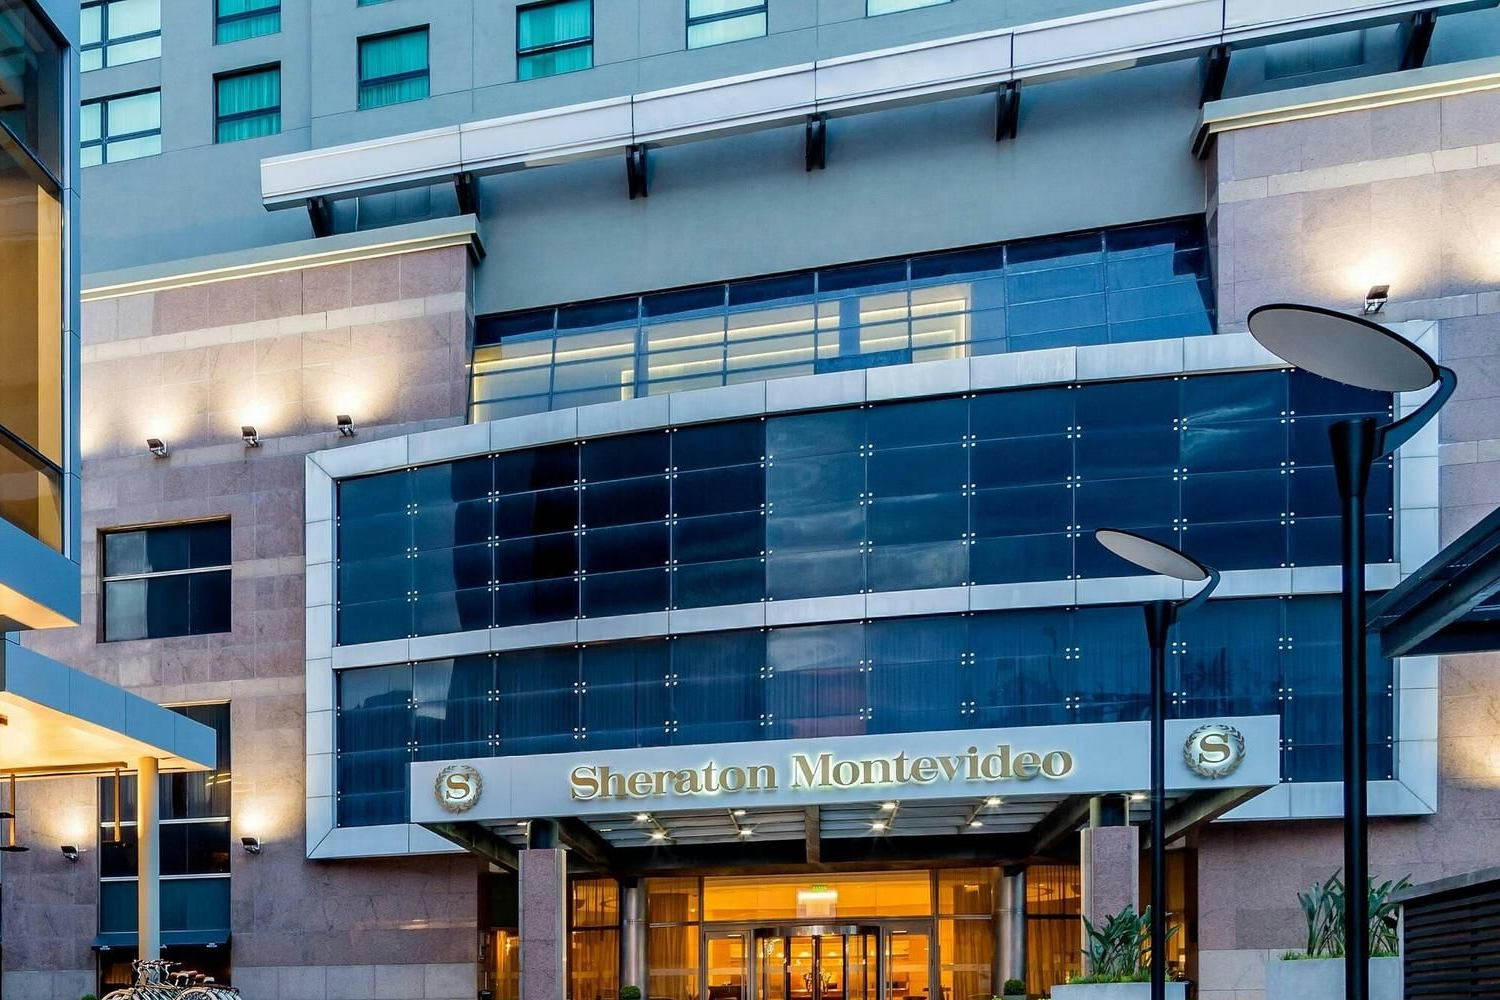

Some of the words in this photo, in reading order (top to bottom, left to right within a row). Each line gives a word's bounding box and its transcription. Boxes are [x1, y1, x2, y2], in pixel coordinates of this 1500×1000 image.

[1199, 733, 1230, 763] S
[446, 773, 469, 799] S
[570, 761, 777, 799] Sheraton
[791, 745, 1074, 788] Montevideo
